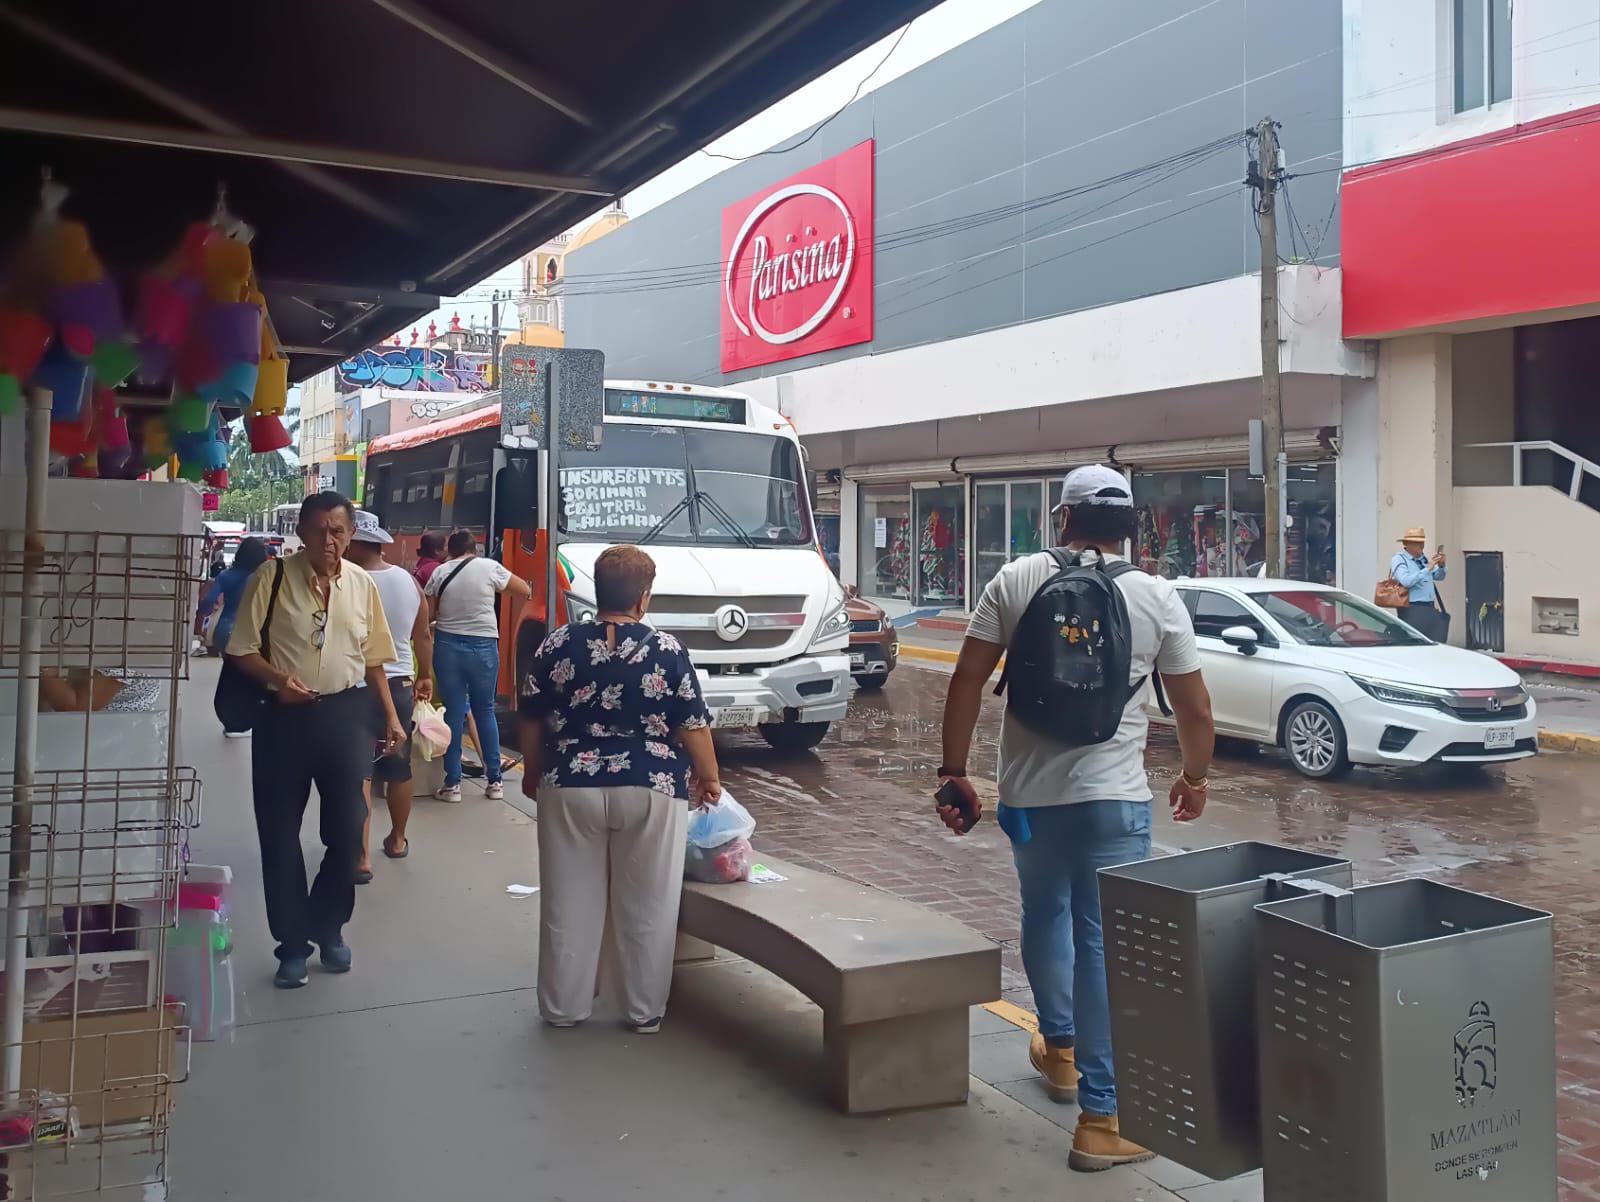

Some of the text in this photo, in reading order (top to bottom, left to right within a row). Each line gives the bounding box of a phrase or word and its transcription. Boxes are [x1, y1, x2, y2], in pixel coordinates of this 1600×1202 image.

[751, 226, 842, 301] Parisina
[1430, 1108, 1520, 1150] MAZATLÁN
[1434, 1155, 1467, 1172] DONDE
[1468, 1151, 1481, 1161] SE
[1456, 1166, 1473, 1180] LAS
